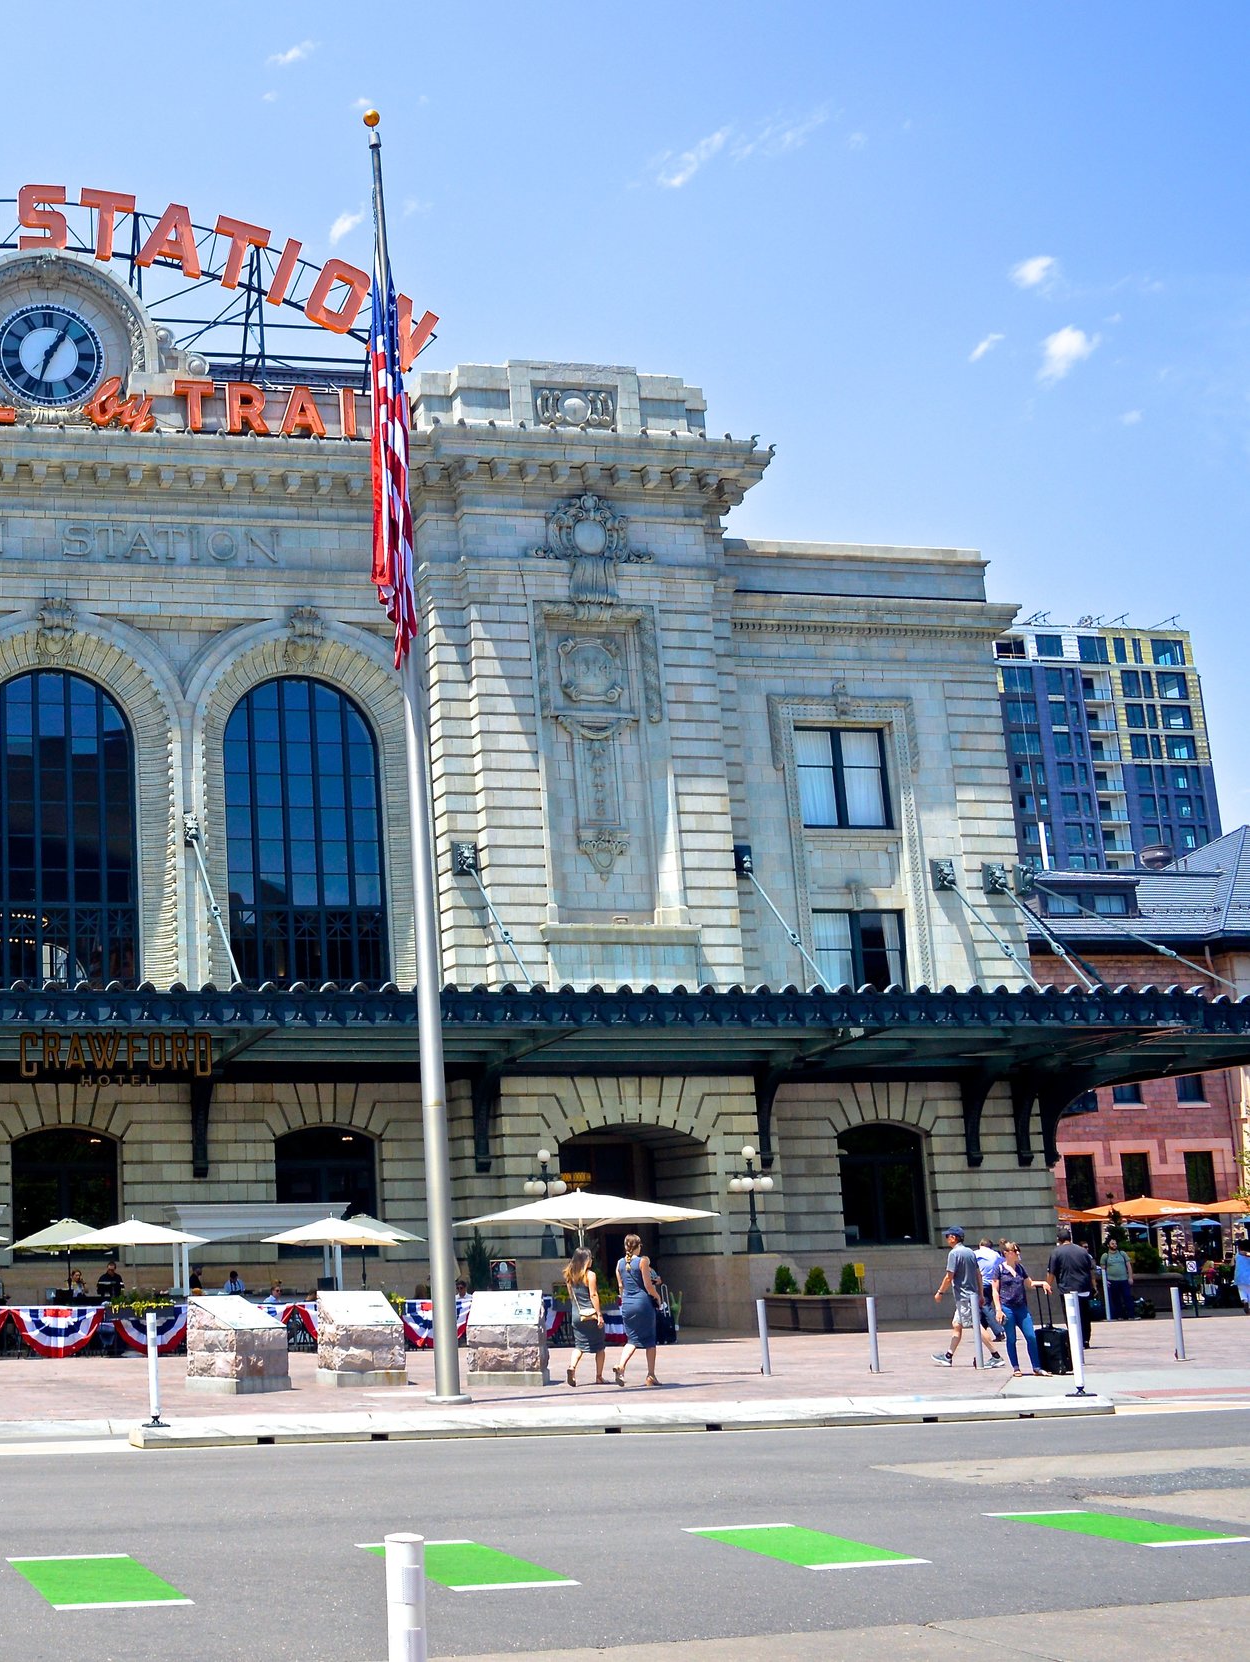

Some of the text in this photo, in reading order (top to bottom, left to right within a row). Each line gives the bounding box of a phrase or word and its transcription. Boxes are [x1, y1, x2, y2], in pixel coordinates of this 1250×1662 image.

[83, 376, 156, 432] by
[172, 379, 411, 437] TRAI
[62, 520, 279, 564] STATION
[19, 1031, 213, 1078] CRAWFORD
[81, 1074, 157, 1087] HOTEL
